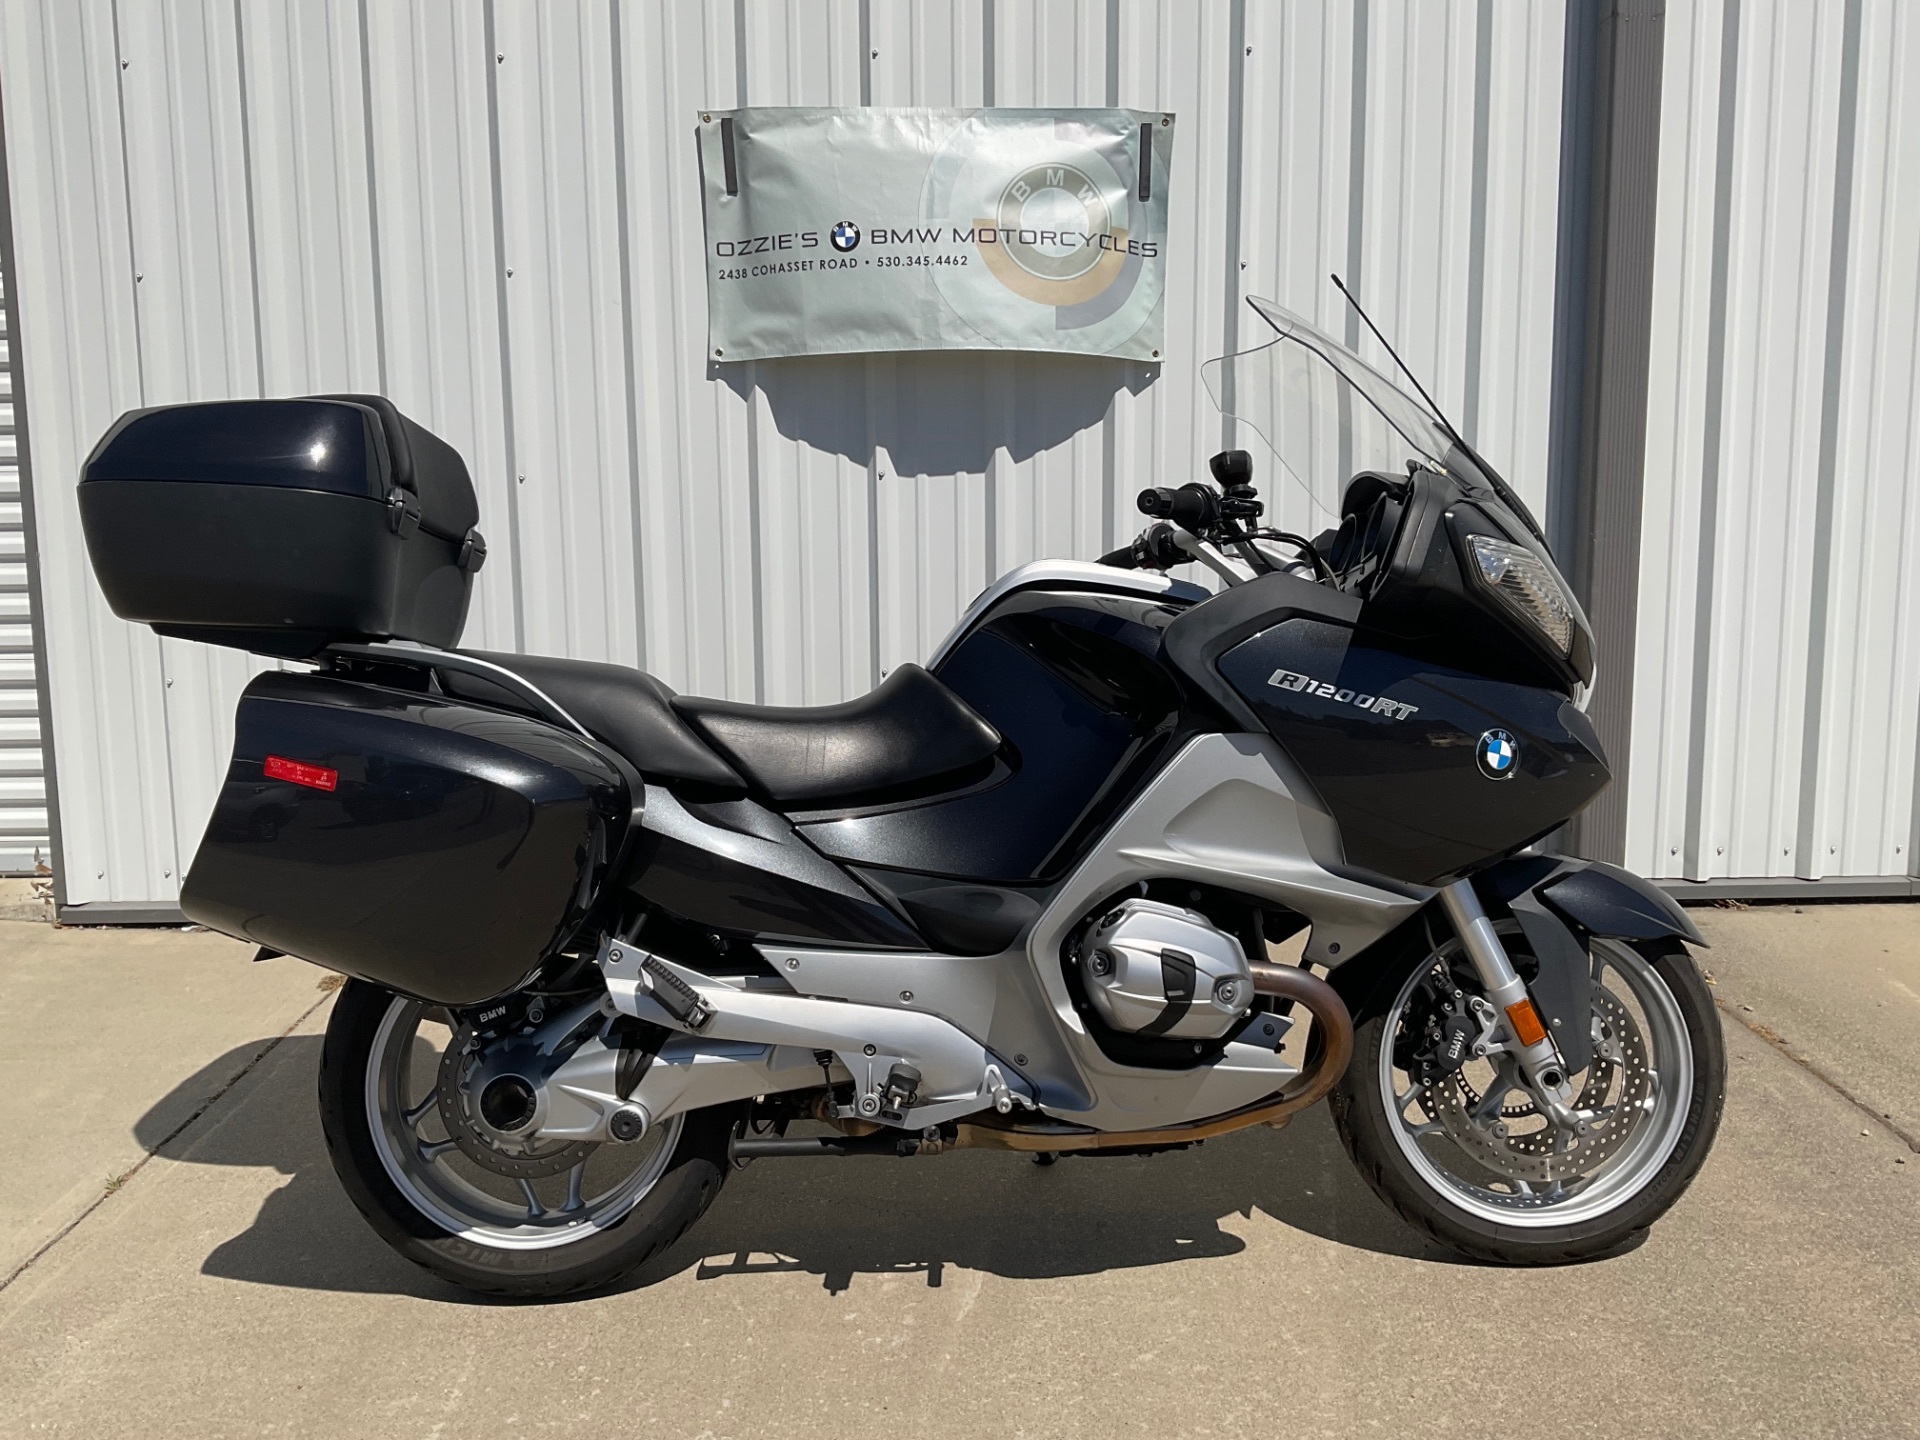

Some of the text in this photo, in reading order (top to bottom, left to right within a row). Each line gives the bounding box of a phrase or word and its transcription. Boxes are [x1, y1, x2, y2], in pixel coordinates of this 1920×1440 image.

[1011, 168, 1099, 206] BMW
[716, 232, 819, 257] OZZIE'S
[870, 228, 1158, 258] BMW MOTORCYCLES
[718, 255, 968, 280] 2438 COHASSET ROAD 530.345.4462
[479, 1005, 507, 1023] BMW
[1447, 1029, 1466, 1059] BMW
[1673, 1081, 1705, 1161] MICHELIN
